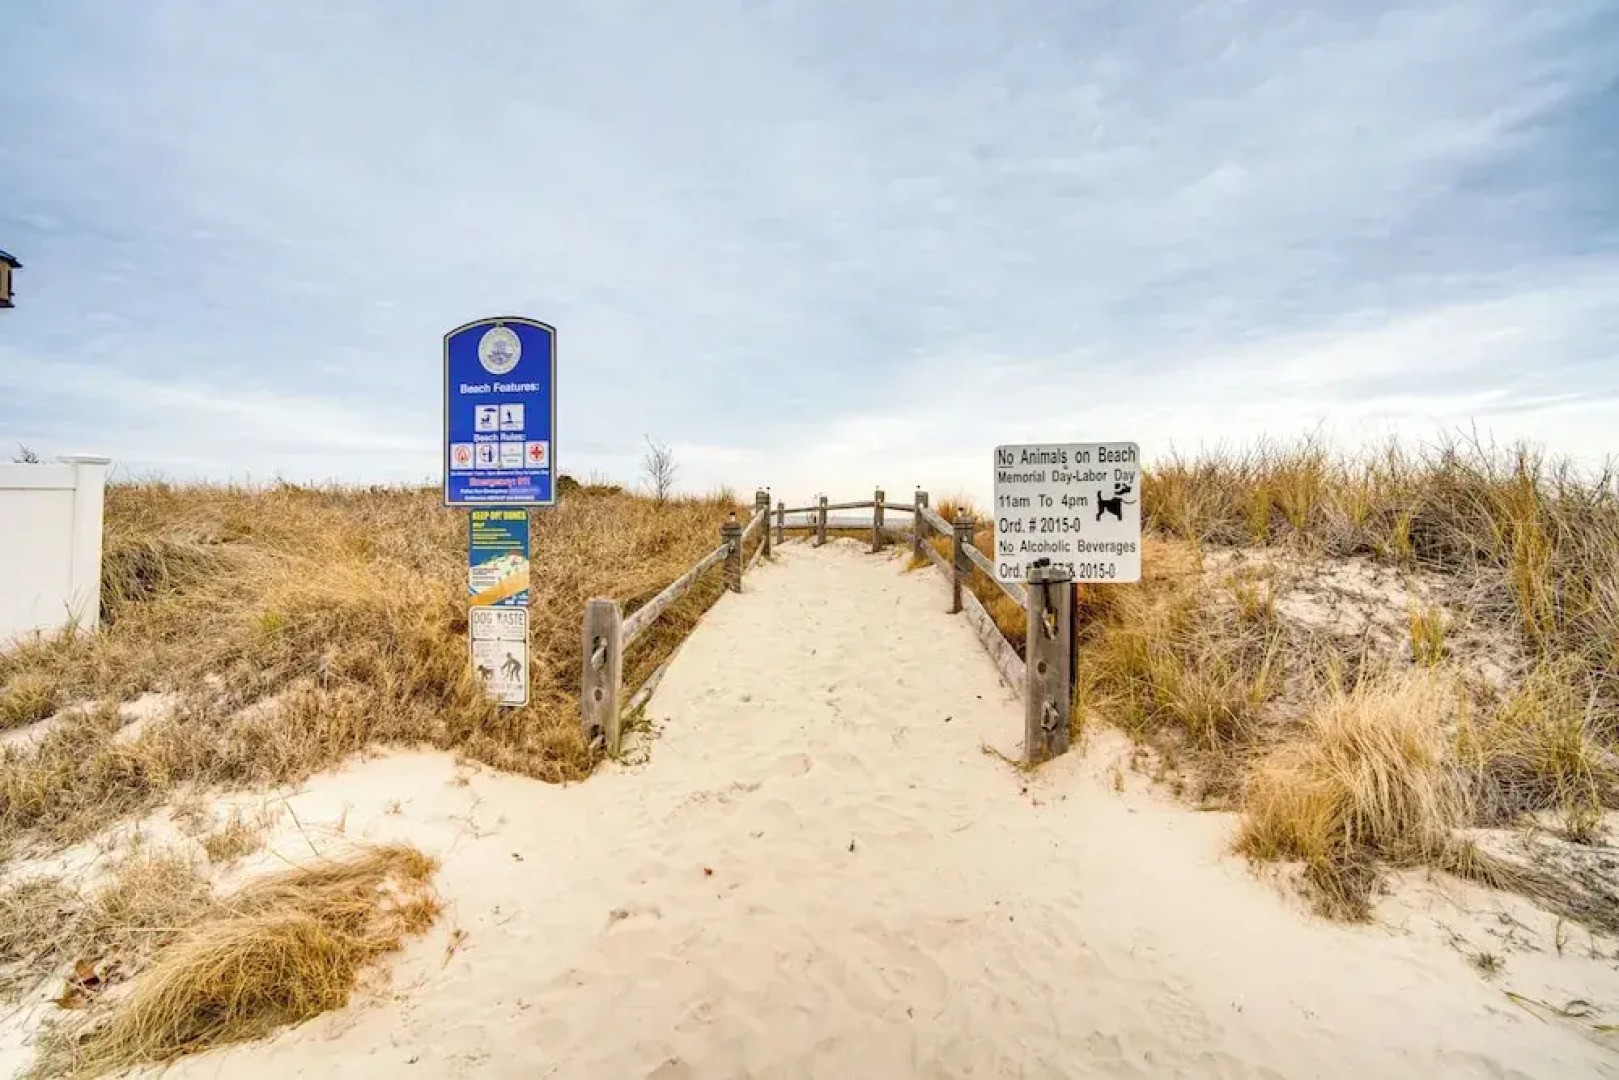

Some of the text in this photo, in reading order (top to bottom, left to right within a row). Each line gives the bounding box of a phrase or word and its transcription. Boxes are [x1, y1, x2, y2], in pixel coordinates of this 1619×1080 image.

[460, 382, 539, 394] Beach Features:
[474, 433, 498, 442] Beach
[998, 446, 1136, 465] No Animals on Beach
[998, 468, 1136, 485] Memorial Day-Labor Day
[998, 493, 1089, 510] 11am To 4pm
[1000, 517, 1081, 533] Ord. # 2015-0
[999, 539, 1136, 556] No Alcoholic Beverages
[1000, 562, 1023, 578] Ord.
[1079, 562, 1117, 579] 2015-0
[474, 612, 524, 626] DOG WASTE
